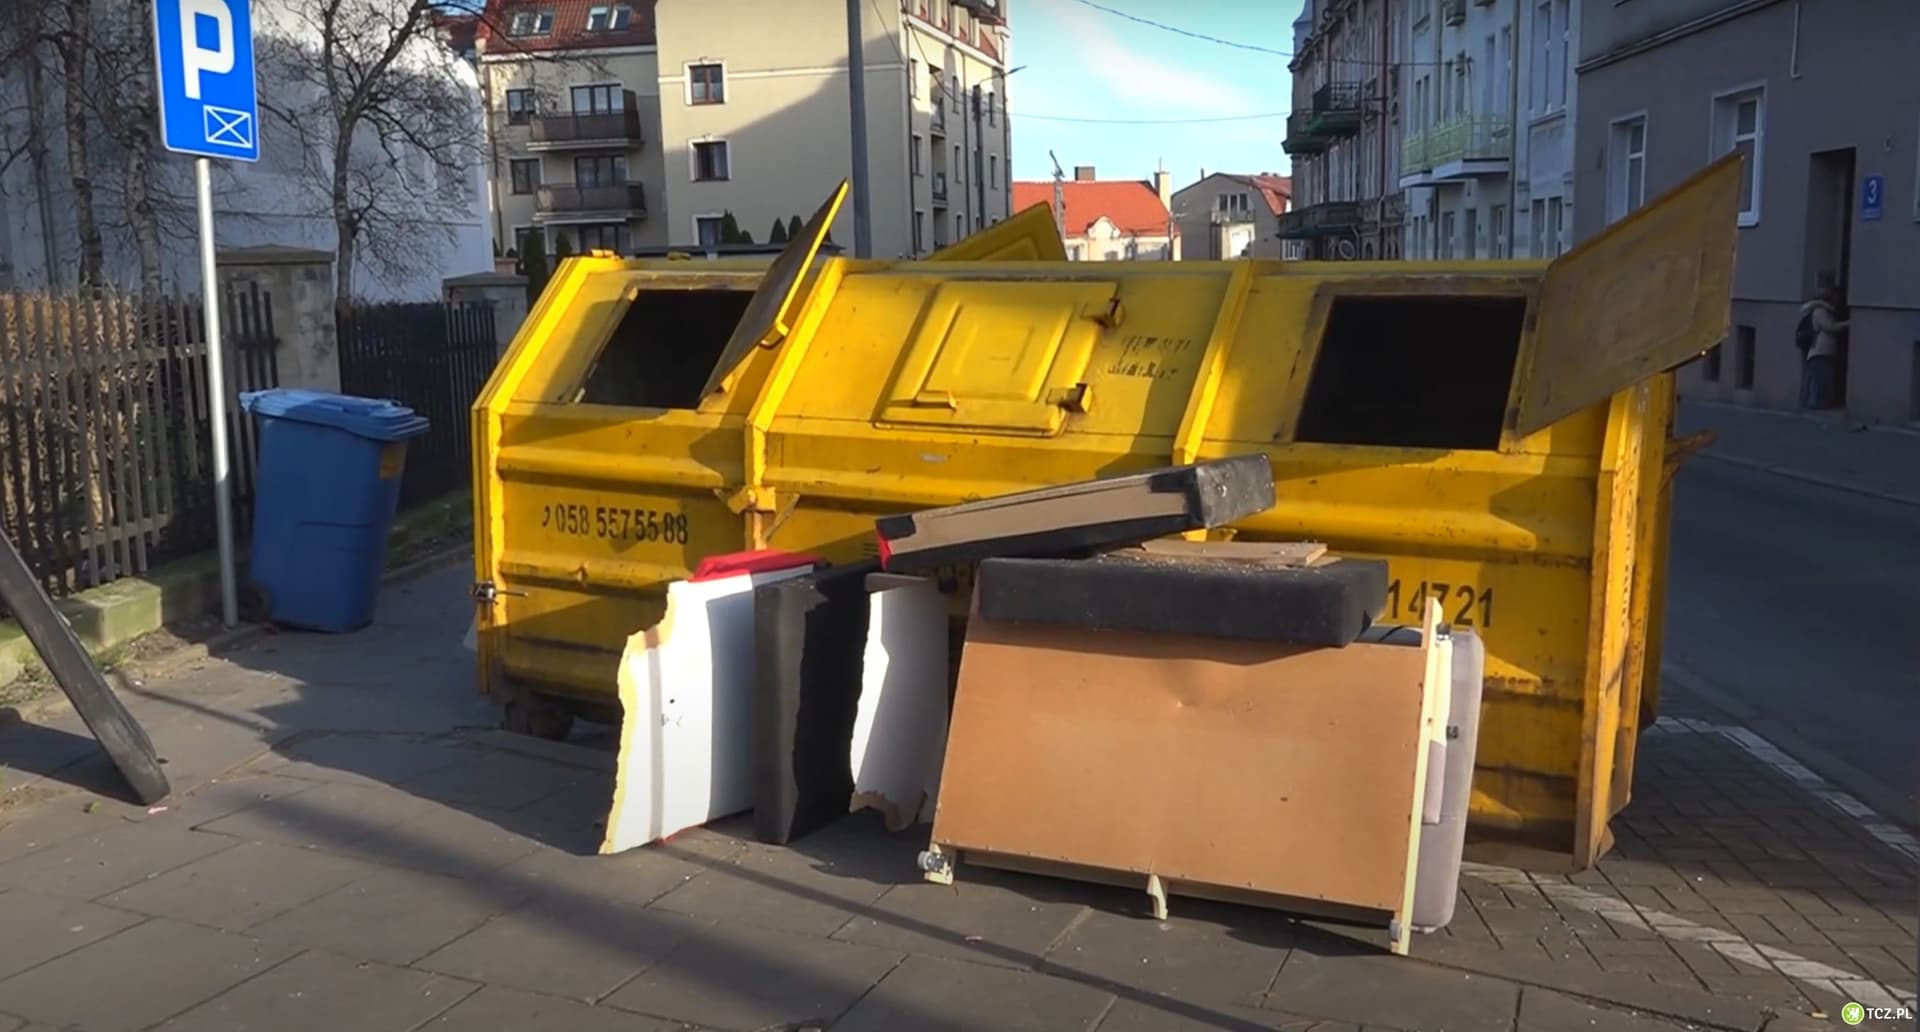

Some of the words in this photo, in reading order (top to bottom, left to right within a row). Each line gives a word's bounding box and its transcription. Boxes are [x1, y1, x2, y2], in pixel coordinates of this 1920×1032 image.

[179, 0, 235, 100] P
[1868, 179, 1878, 203] 3
[554, 503, 590, 535] 058
